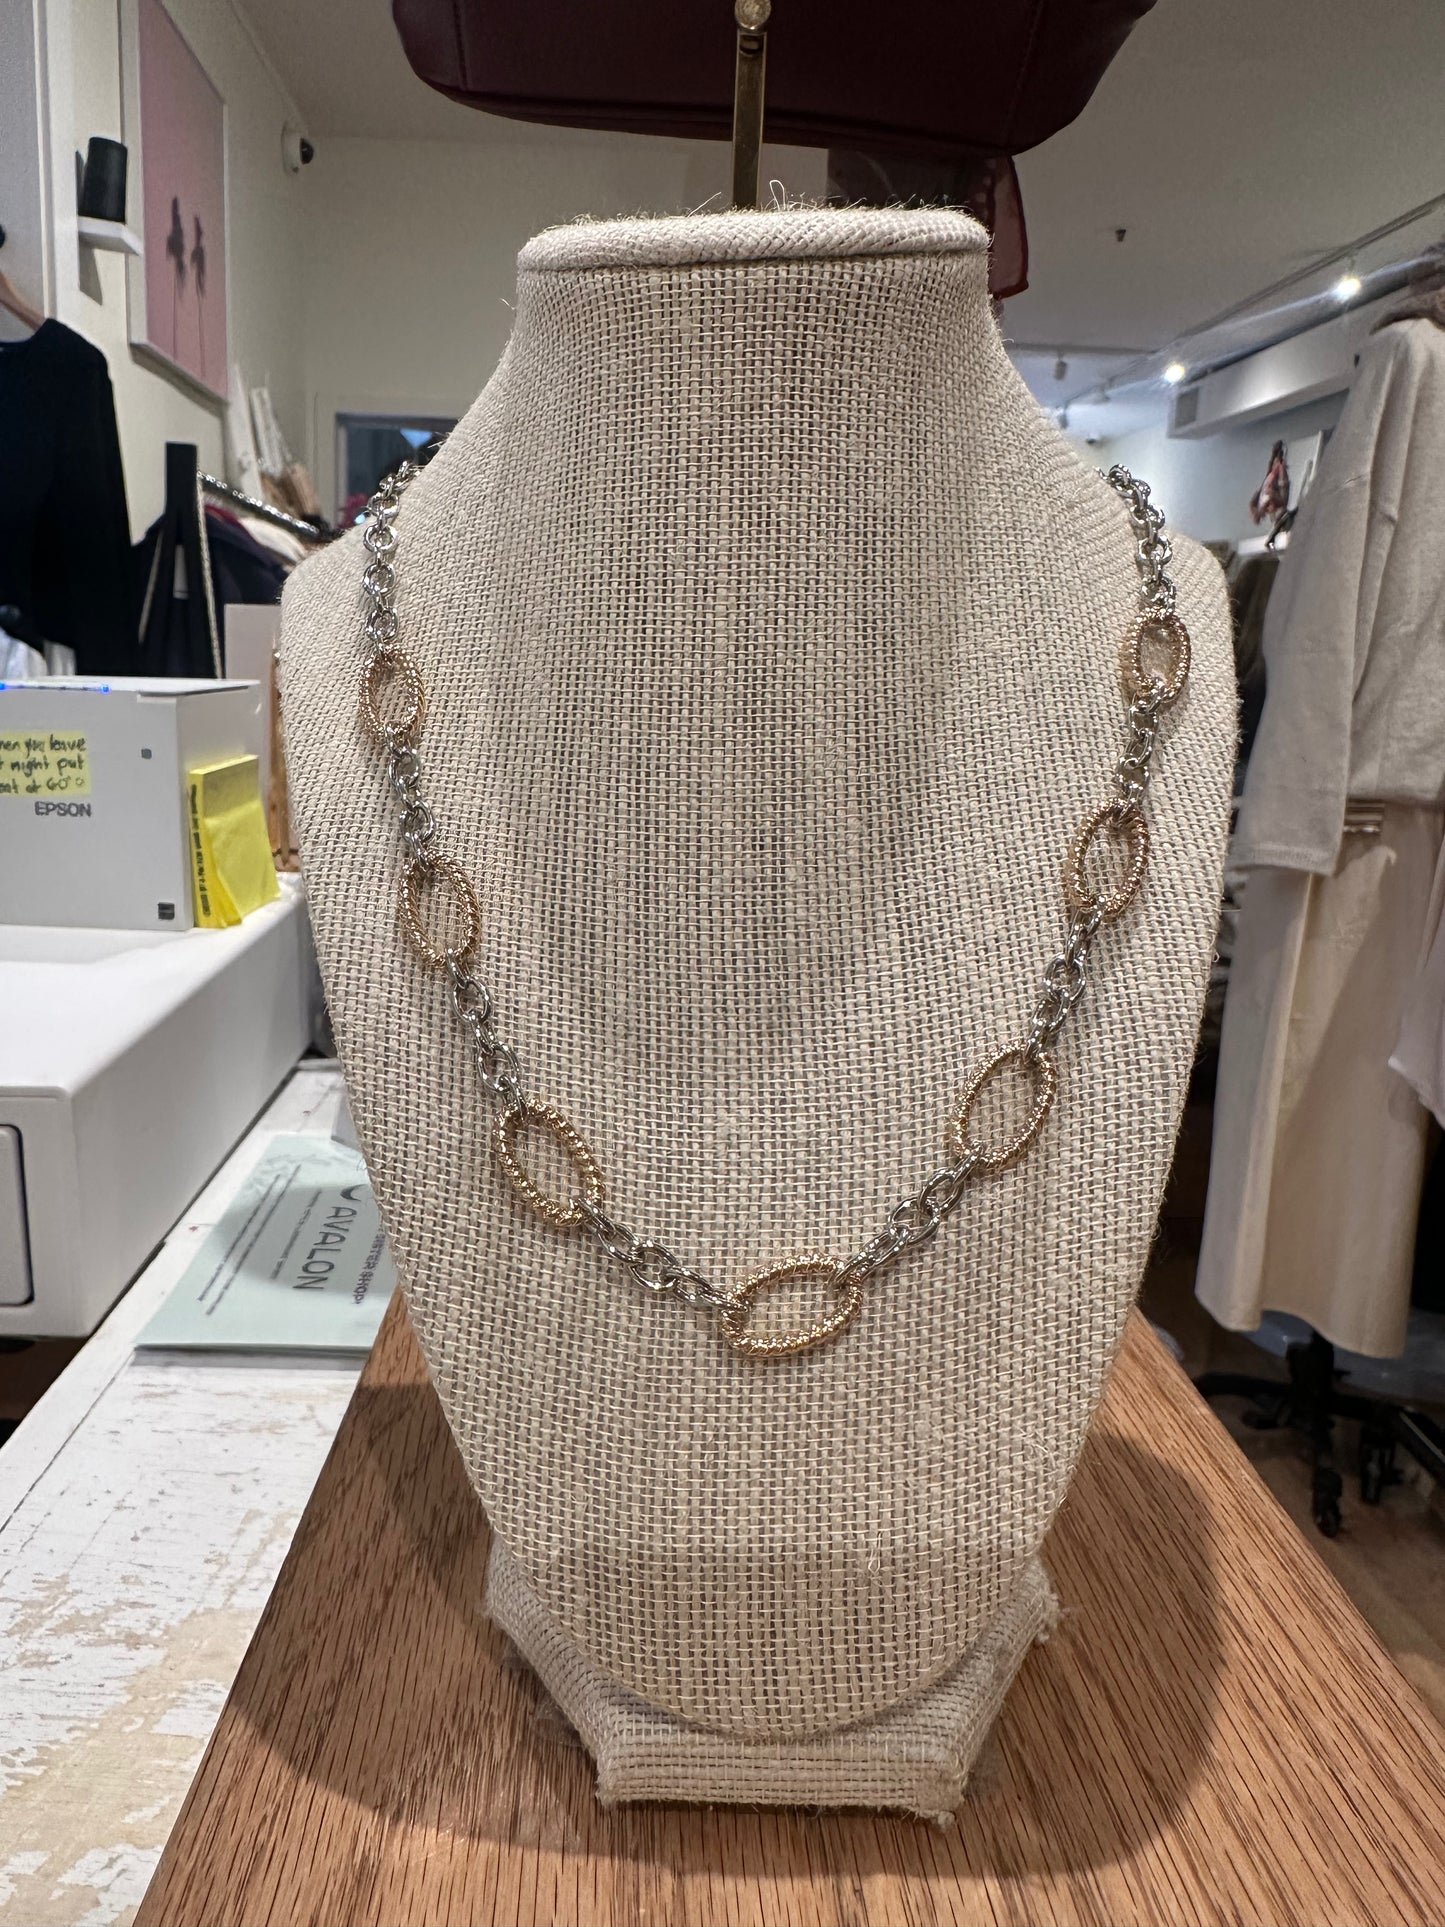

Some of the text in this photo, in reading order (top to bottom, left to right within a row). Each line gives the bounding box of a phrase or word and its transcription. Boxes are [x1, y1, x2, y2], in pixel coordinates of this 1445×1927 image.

[50, 733, 86, 752] leave
[57, 753, 84, 776] put
[35, 801, 92, 817] EPSON
[292, 1205, 358, 1291] AVALON
